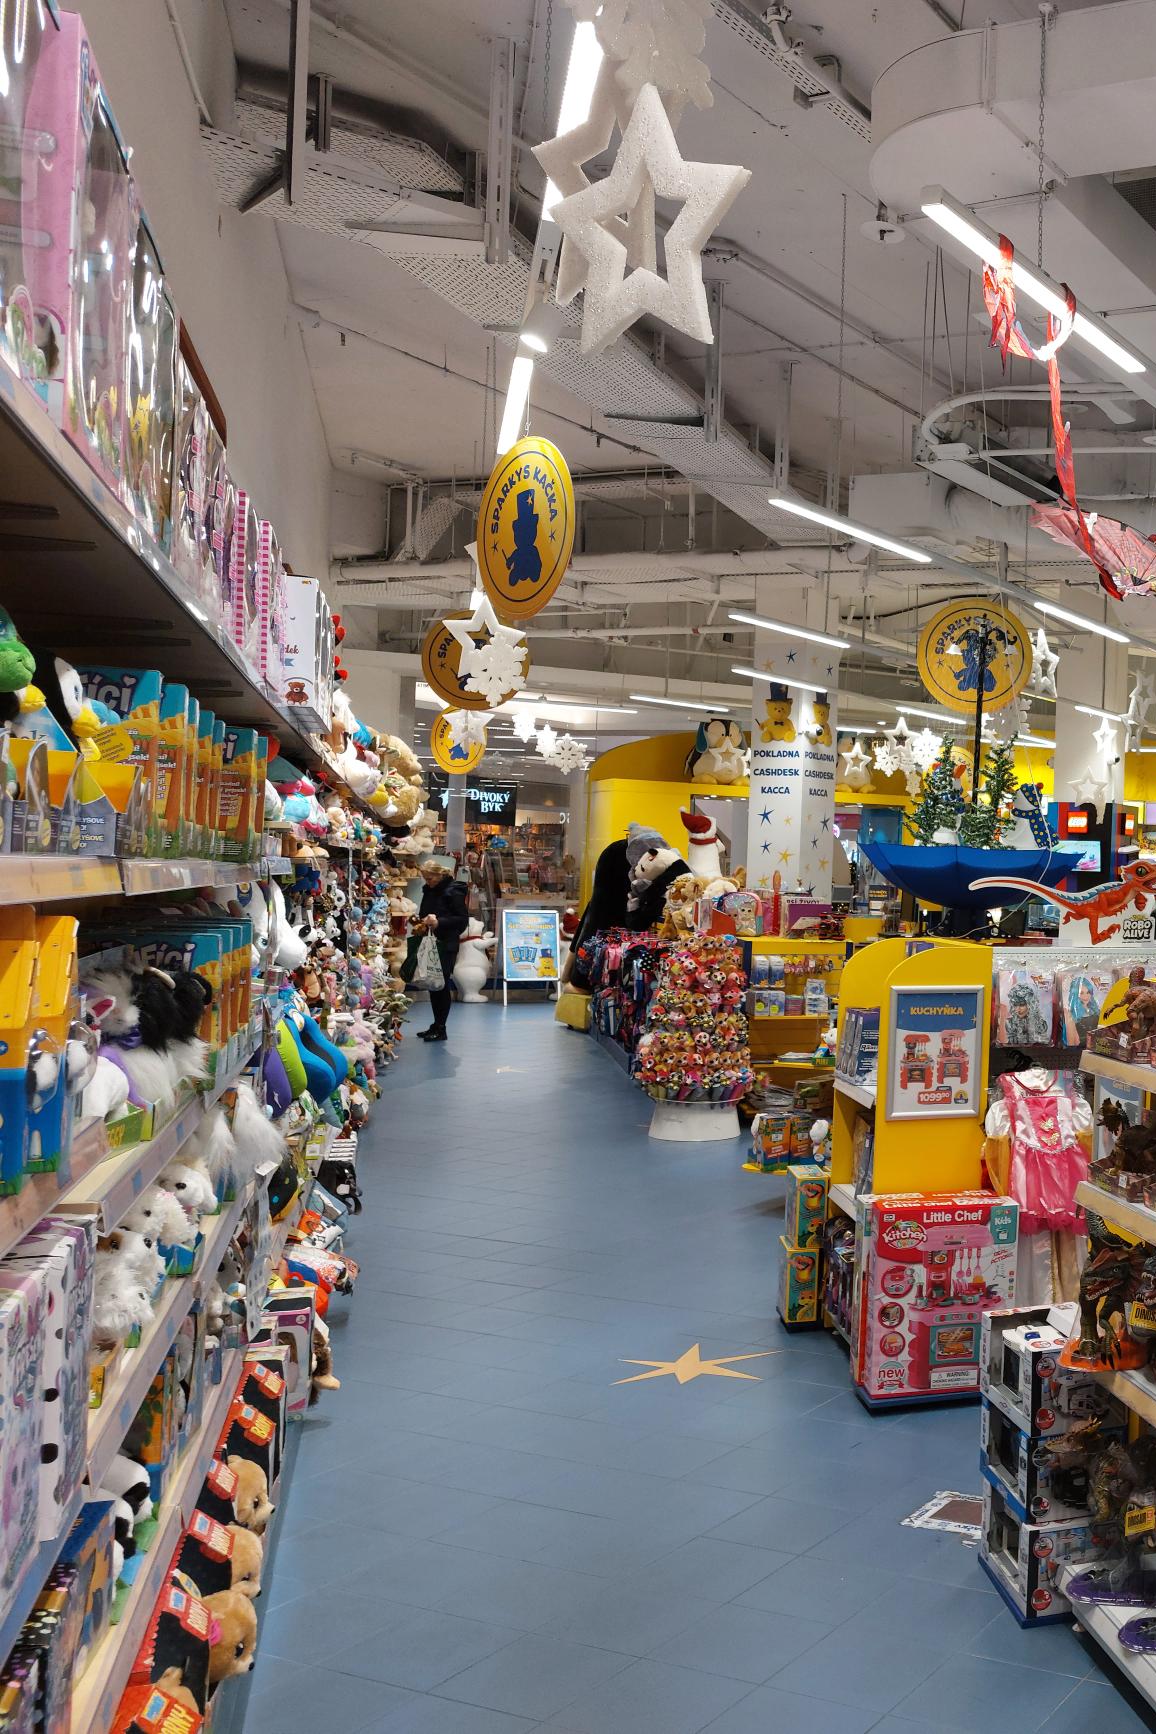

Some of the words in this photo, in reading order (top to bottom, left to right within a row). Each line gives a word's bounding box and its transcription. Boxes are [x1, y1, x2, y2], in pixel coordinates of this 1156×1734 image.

[491, 464, 530, 534] SPARKYS
[533, 466, 558, 522] KAČKA
[753, 750, 800, 758] POKLADNA
[805, 751, 835, 762] POKLADNA
[753, 768, 800, 776] CASHDESK
[804, 769, 834, 780] CASHDESK
[468, 787, 510, 802] DIVOKÝ
[480, 800, 504, 813] BÝK
[1123, 919, 1152, 930] ROBO
[1123, 929, 1150, 939] ALIVE
[910, 1004, 964, 1015] KUCHYŇKA
[923, 1212, 952, 1223] Little
[954, 1209, 983, 1222] Chef
[994, 1216, 1012, 1226] Kids
[882, 1227, 928, 1243] Kitchen
[878, 1367, 905, 1379] new
